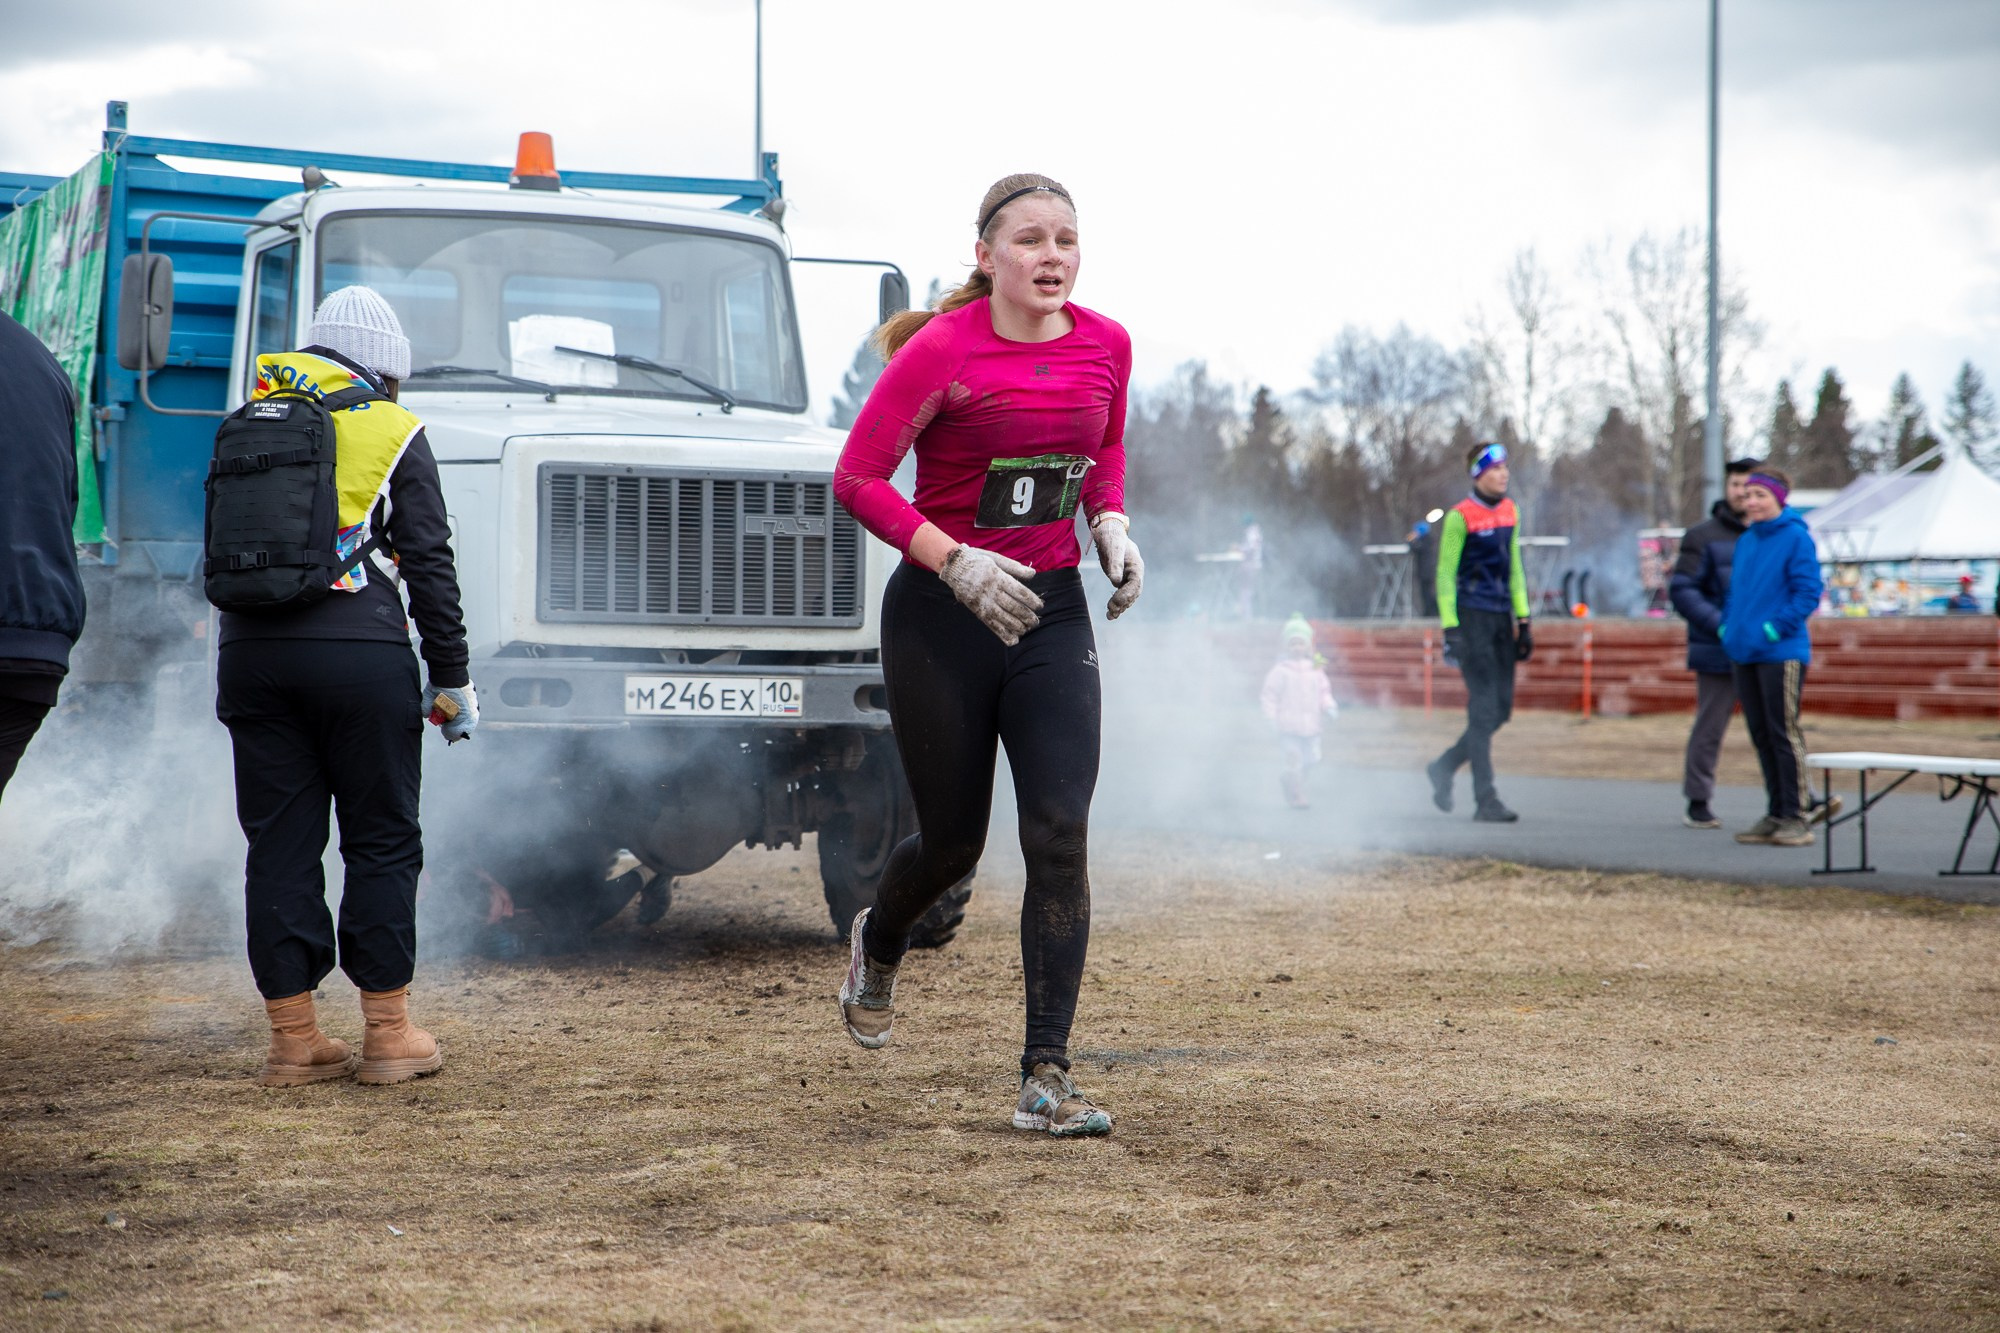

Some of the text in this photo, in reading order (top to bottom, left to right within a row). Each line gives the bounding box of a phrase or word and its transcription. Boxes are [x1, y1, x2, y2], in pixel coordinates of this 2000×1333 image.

[1070, 462, 1086, 476] 6
[1011, 476, 1035, 516] 9
[375, 604, 393, 617] 4F
[766, 681, 792, 703] 10
[762, 703, 784, 713] RUS
